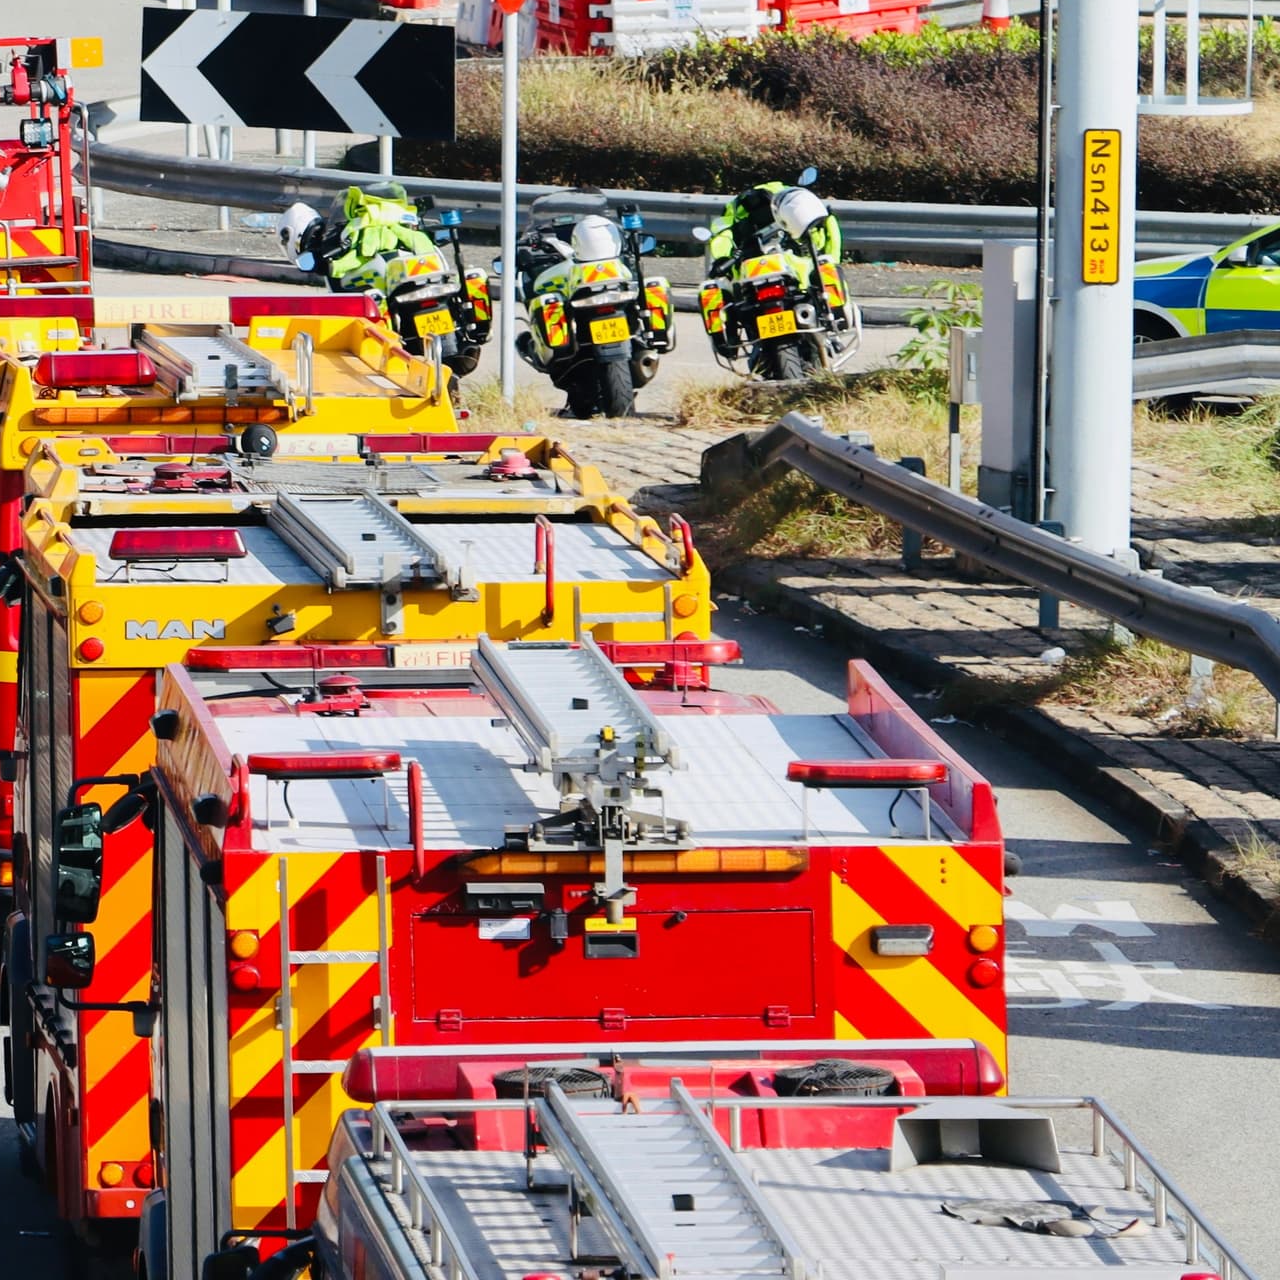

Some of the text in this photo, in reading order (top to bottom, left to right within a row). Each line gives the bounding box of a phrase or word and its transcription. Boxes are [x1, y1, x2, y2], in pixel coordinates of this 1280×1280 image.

[1090, 138, 1111, 253] Nsn413
[131, 303, 193, 320] FIRE
[125, 619, 226, 640] MAN
[437, 650, 471, 666] FIR
